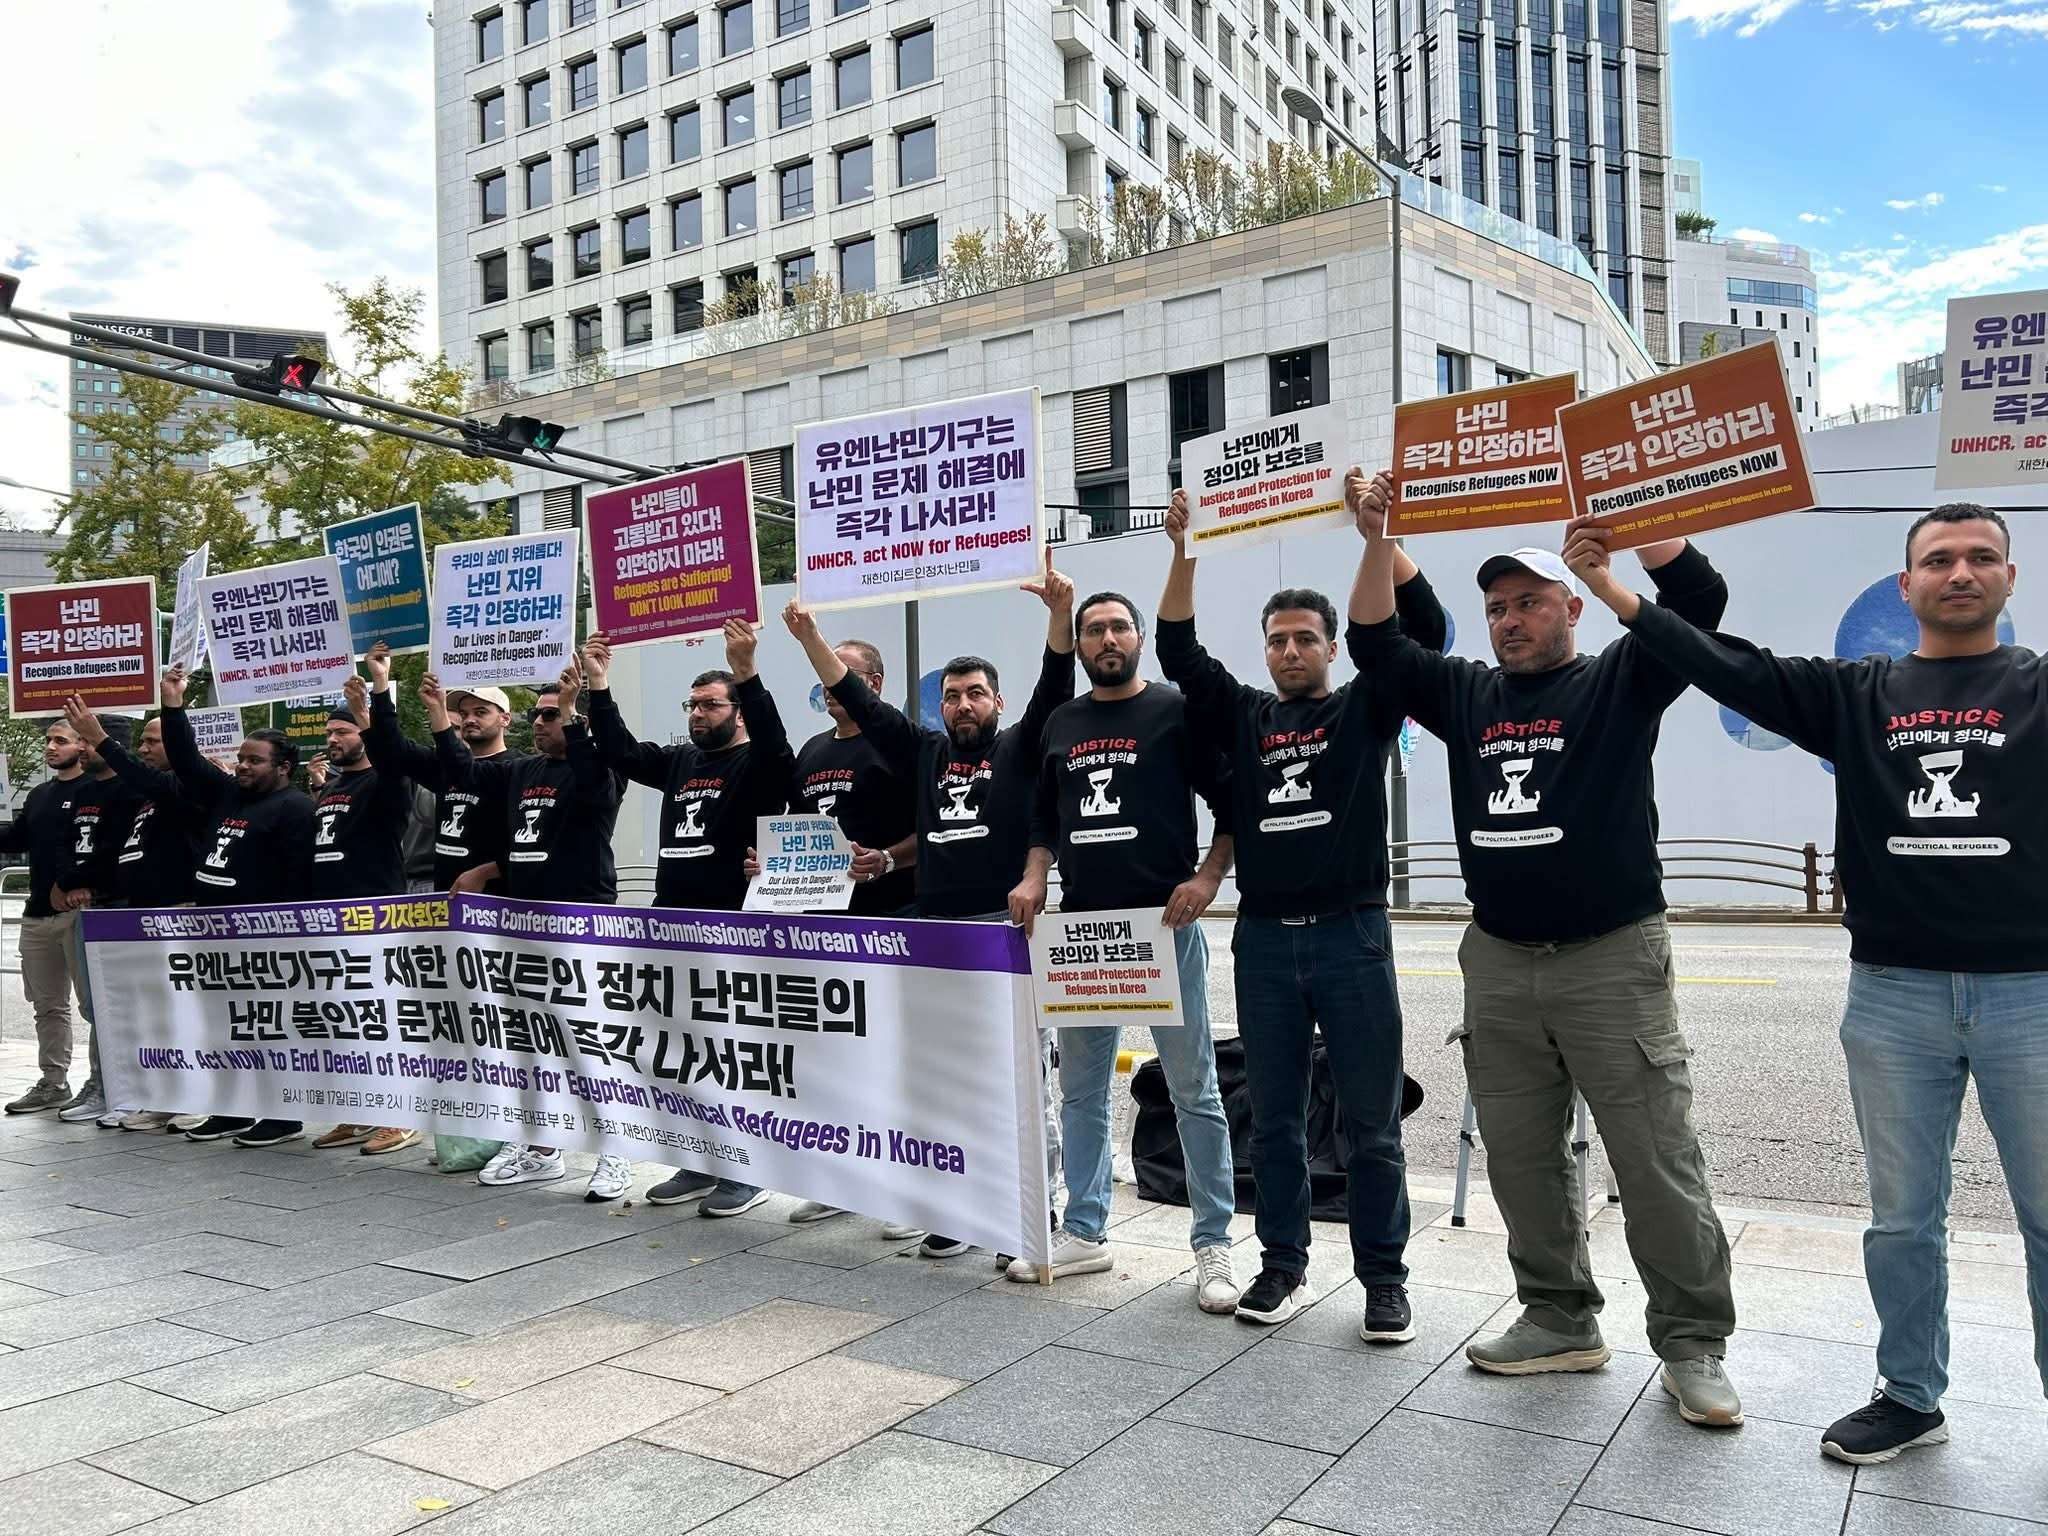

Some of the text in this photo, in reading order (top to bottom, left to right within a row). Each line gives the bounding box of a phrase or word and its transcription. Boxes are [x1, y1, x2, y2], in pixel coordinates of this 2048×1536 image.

[1961, 354, 2032, 391] 난민
[1456, 399, 1508, 434] 난민
[1630, 384, 1696, 433] 난민
[815, 415, 1015, 473] 유엔난민기구는
[1223, 422, 1300, 460] 난민에게
[1403, 440, 1453, 471] 즉각
[1580, 402, 1776, 481] 즉각 인정하라
[1951, 434, 2016, 454] UNHCR,
[808, 448, 1025, 509] 난민 문제 해결에
[1203, 441, 1324, 488] 정의와 보호를
[1199, 467, 1332, 508] Justice and Protection for
[1405, 467, 1558, 498] Recognise Refugees NOW
[1591, 483, 1665, 513] Recognise
[1666, 463, 1738, 496] Refugees
[1741, 450, 1779, 475] NOW
[631, 483, 697, 521] 난민들이
[835, 490, 996, 541] 즉각 나서라!
[1219, 487, 1314, 519] Refugees in Korea
[335, 522, 414, 566] 한국의 인권은
[613, 506, 722, 551] 고통받고 있다!
[451, 541, 562, 570] 우리의 삶이 위태롭다!
[616, 536, 724, 580] 외면하지 마라!
[808, 525, 1032, 571] UNHCR, act NOW for Refugees!
[356, 558, 400, 591] 어디에?
[467, 565, 542, 598] 난민 지위
[613, 564, 732, 600] Refugees are Suffering!
[861, 559, 981, 585] 재한이집트인정치난민들
[212, 575, 329, 613] 유엔난민기구는
[629, 587, 718, 617] DON'T LOOK AWAY!
[60, 598, 100, 624] 난민
[211, 615, 246, 640] 난민
[249, 608, 283, 634] 문제
[287, 600, 339, 627] 해결에
[446, 604, 480, 629] 즉각
[21, 630, 60, 654] 즉각
[64, 623, 143, 652] 인정하라
[232, 639, 266, 662] 즉각
[270, 629, 327, 657] 나서라!
[443, 643, 563, 665] Recognize Refugees NOW!
[453, 629, 542, 648] Our Lives in Danger
[25, 659, 140, 678] Recognise Refugees NOW
[253, 666, 267, 678] act
[269, 663, 288, 676] NOW
[290, 661, 303, 673] for
[306, 654, 349, 671] Refugees!
[1481, 719, 1563, 741] JUSTICE
[1887, 709, 2004, 730] JUSTICE
[1068, 738, 1137, 757] JUSTICE
[1479, 737, 1565, 758] 난민에게 정의를
[1886, 728, 2007, 751] 난민에게 정의를
[806, 768, 854, 785] JUSTICE
[1066, 753, 1106, 772] 난민에게
[1907, 842, 1999, 850] POLITICAL REFUGEES
[140, 901, 450, 938] 유엔난민기구 최고대표 방한 긴급 기자회견
[462, 903, 911, 957] Press Conference: UNHCR Commissioner's Korean visit
[1065, 920, 1132, 942] 난민에게
[1049, 942, 1154, 965] 정의와 보호를
[168, 945, 867, 1037] 유엔난민기구는 재한 이집트인 정치 난민들의
[1047, 967, 1161, 982] Justice and Protection for
[1065, 983, 1147, 996] Refugees in Korea
[228, 999, 797, 1100] 난민 불인정 문제 해결에 즉각 나서라!
[139, 1047, 965, 1175] UNHCR, Act NOW to End Denial of Refugee Status for Egyptian Political Refugees in Korea
[306, 1089, 752, 1166] 10월 17일(금) 오후 2시 유엔난민기구 한국대표부 앞 주최: 재한이집트인정치난민들
